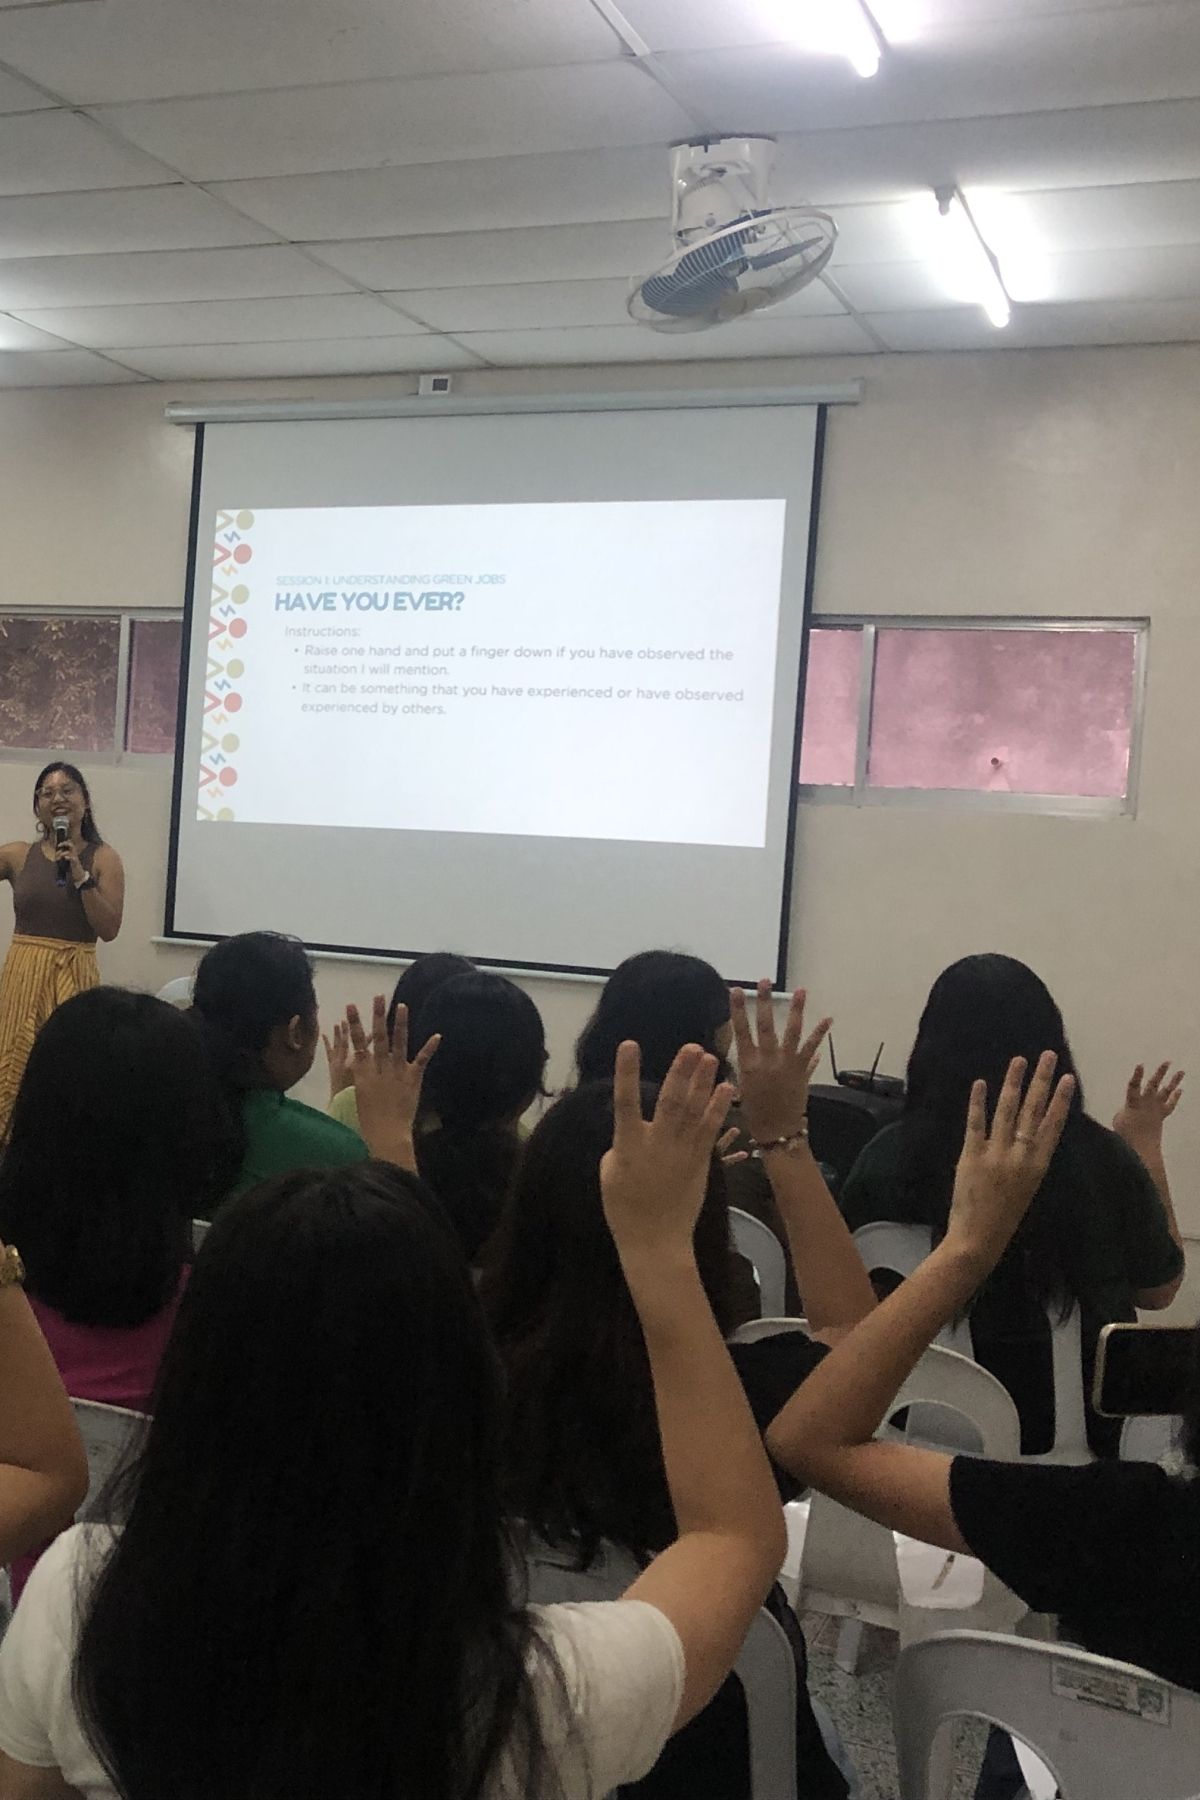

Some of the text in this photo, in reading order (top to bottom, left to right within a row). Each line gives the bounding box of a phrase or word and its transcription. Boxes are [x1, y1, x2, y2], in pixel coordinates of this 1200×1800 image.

[276, 576, 322, 586] SESSION
[333, 575, 431, 585] UNDERSTANDING
[433, 575, 472, 585] GREEN
[475, 575, 506, 585] JOBS
[275, 592, 464, 611] HAVE YOU EVER?
[285, 626, 360, 637] Instructions:
[304, 645, 338, 656] Raise
[341, 647, 365, 656] one
[369, 646, 401, 656] hand
[405, 646, 429, 657] and
[433, 647, 456, 660] put
[471, 646, 509, 660] finger
[514, 647, 552, 658] down
[556, 647, 565, 658] if
[570, 649, 595, 660] you
[600, 647, 633, 659] have
[637, 648, 704, 660] observed
[710, 649, 734, 660] the
[304, 664, 357, 674] situation
[369, 664, 390, 675] will
[394, 665, 449, 676] mention.
[302, 683, 744, 701] It can be something that you have experienced or have observed
[301, 702, 446, 715] experienced by others.
